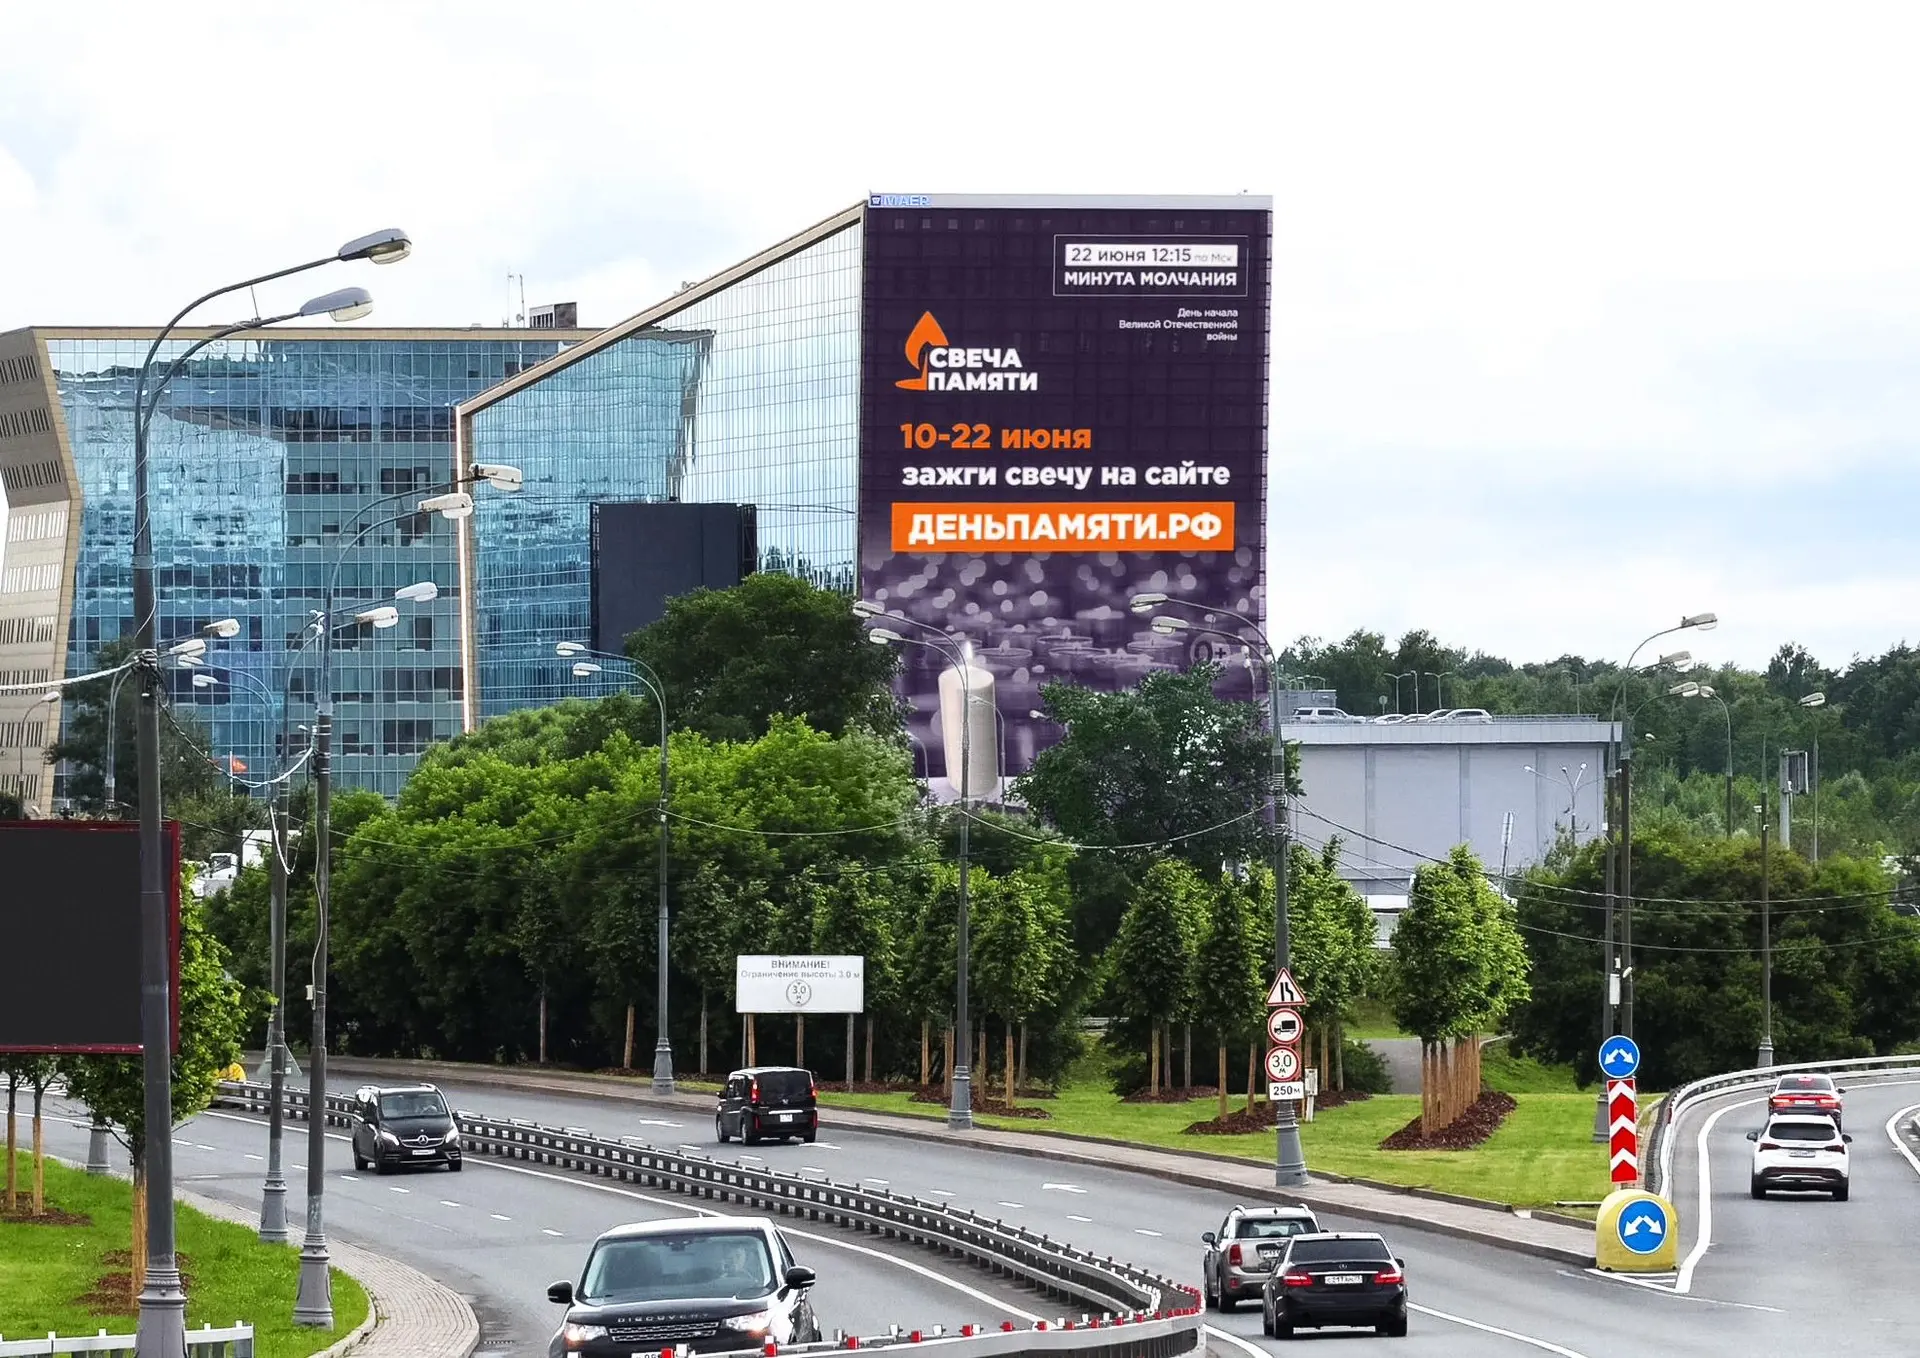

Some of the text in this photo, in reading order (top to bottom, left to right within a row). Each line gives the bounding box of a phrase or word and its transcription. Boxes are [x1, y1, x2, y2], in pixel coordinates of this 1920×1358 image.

[883, 195, 930, 206] MAER
[1071, 248, 1092, 262] 22
[1098, 250, 1146, 262] июня
[1152, 248, 1191, 262] 12:15
[1195, 254, 1208, 262] по
[1064, 272, 1237, 286] МИНУТА МОЛЧАНИЯ
[1177, 308, 1202, 318] День
[1119, 319, 1238, 329] Великой Отечественной
[1206, 332, 1238, 341] войны
[929, 347, 1023, 368] СВЕЧА
[927, 372, 1038, 391] ПАМЯТИ
[900, 423, 1091, 448] 10-22 июня
[902, 461, 1230, 489] зажги свечу на сайте
[908, 512, 1222, 545] ДЕНЬПАМЯТИ.РФ
[771, 960, 830, 968] ВНИМАНИЕ!
[1273, 1086, 1293, 1096] 250
